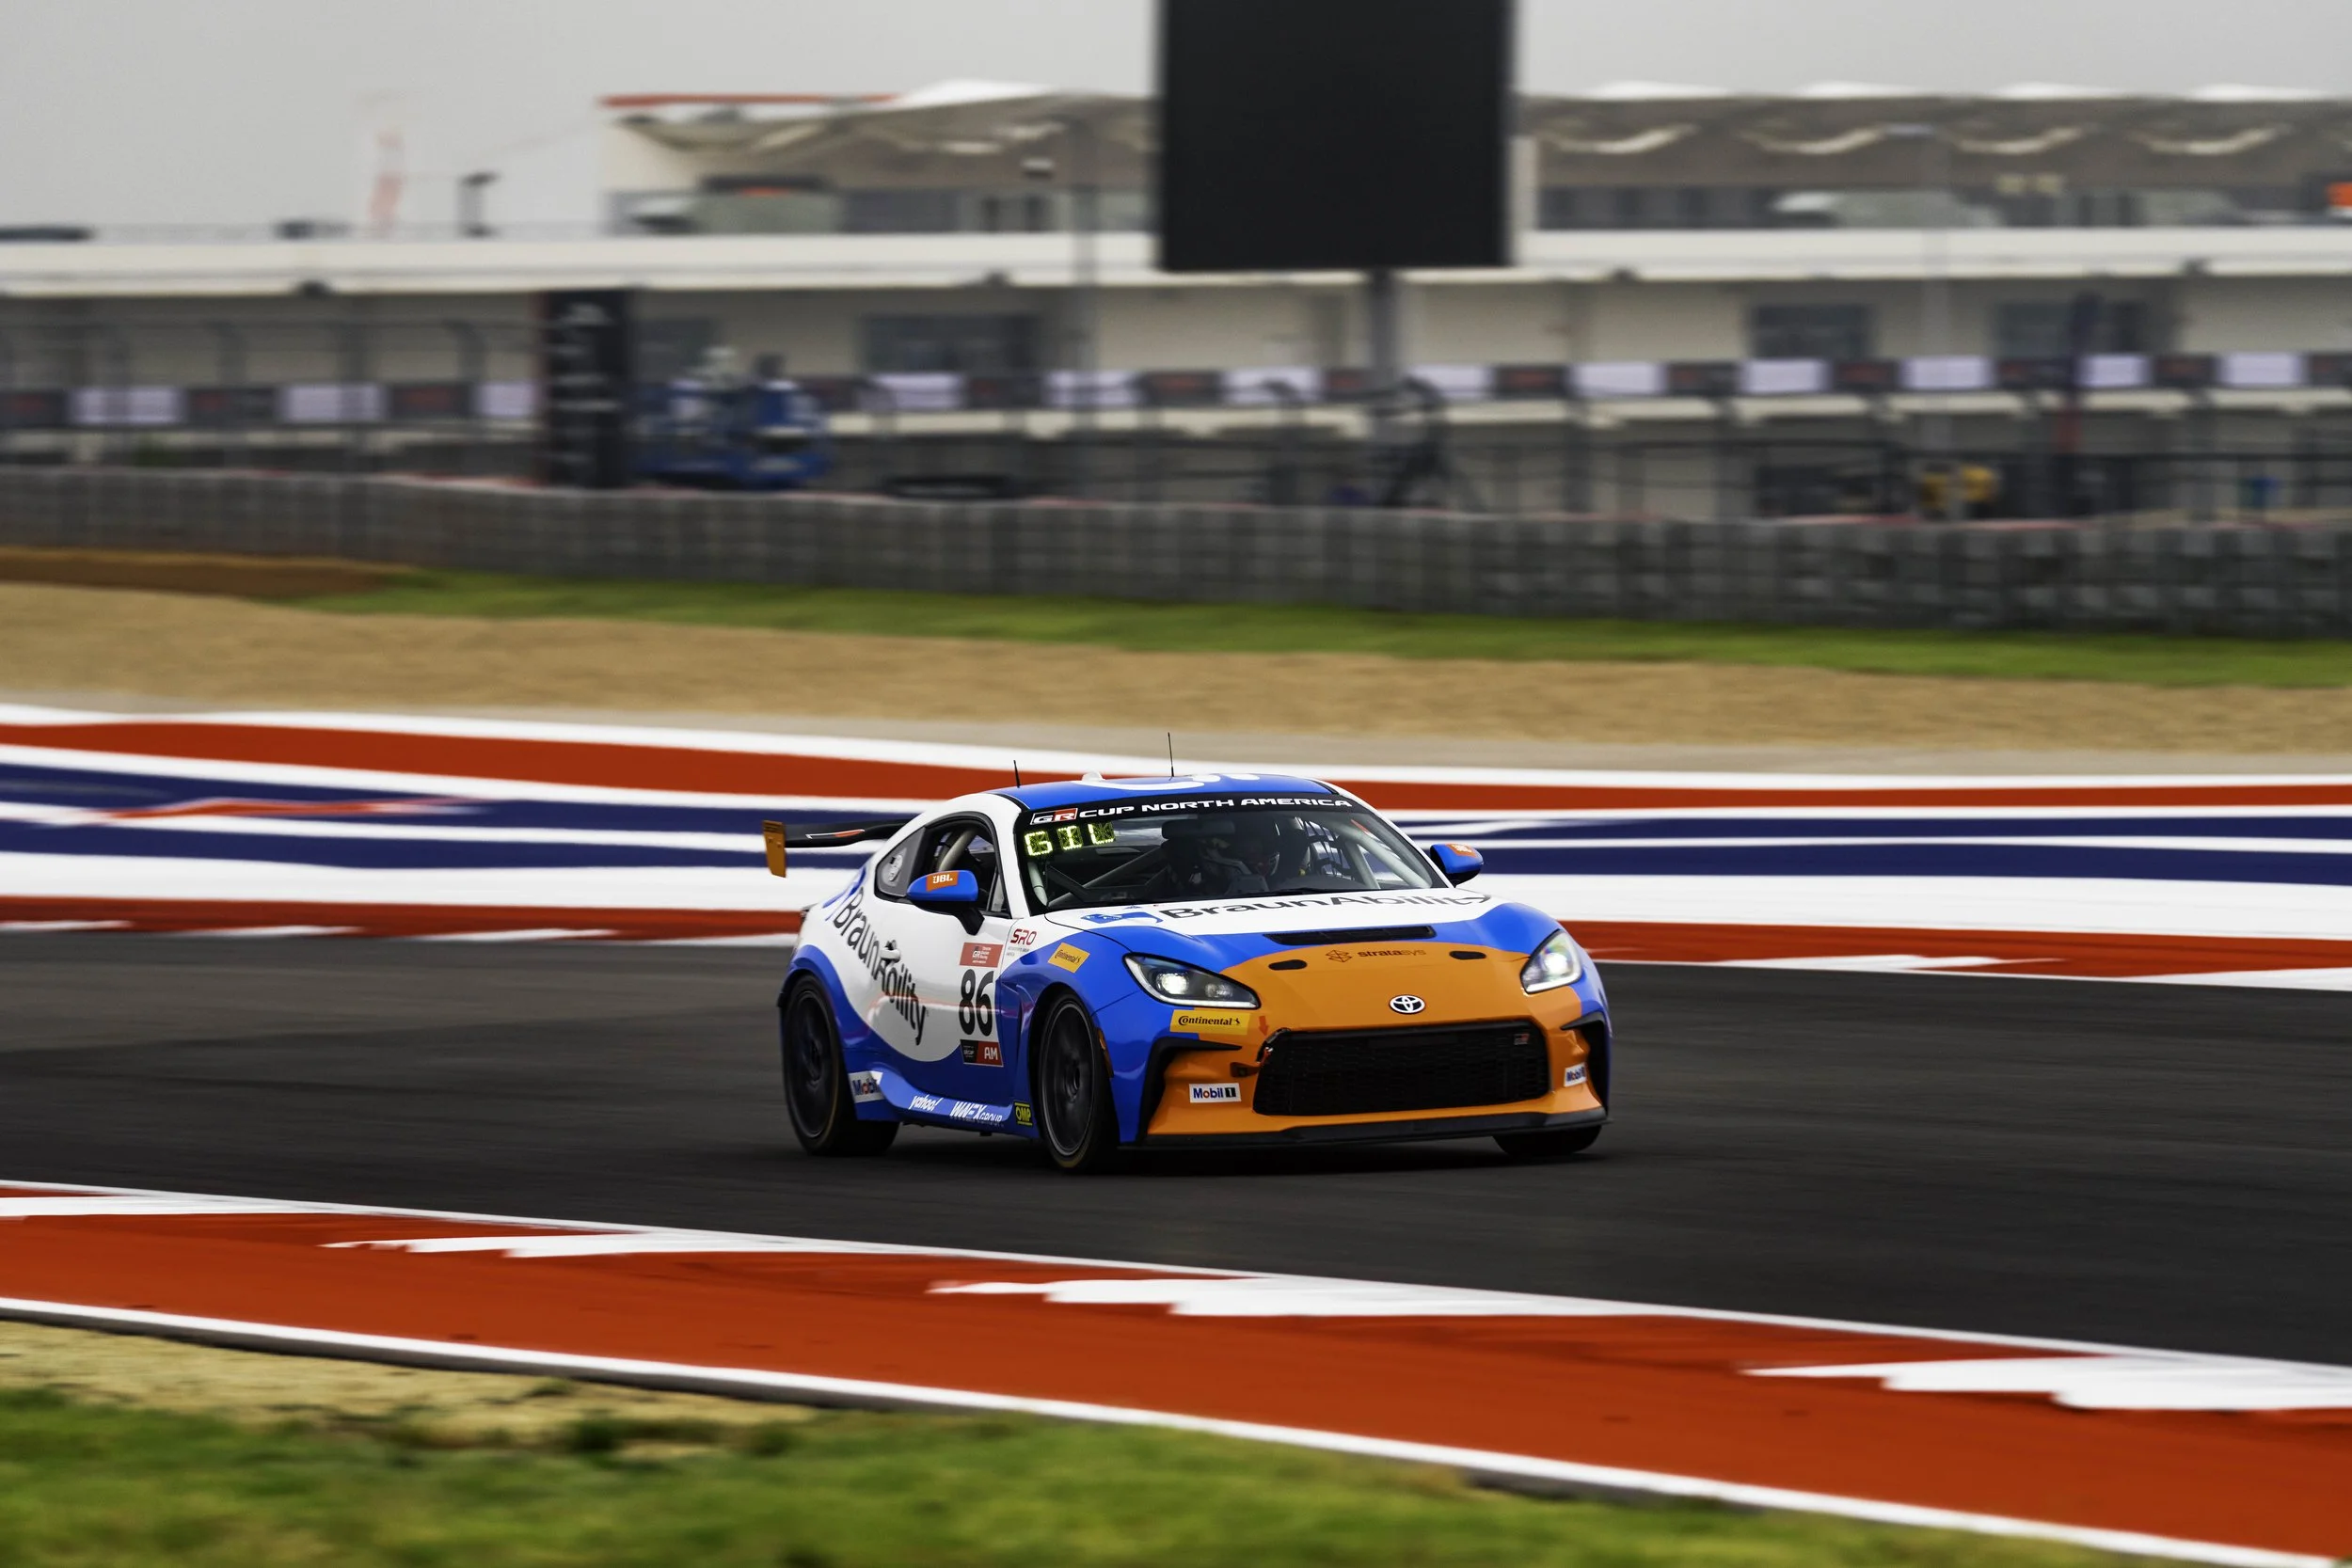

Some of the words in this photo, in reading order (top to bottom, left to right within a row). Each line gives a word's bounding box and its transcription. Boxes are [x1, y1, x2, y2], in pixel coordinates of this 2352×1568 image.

[1032, 812, 1075, 824] GR
[1079, 806, 1135, 818] CUP
[1141, 800, 1234, 813] NORTH
[1240, 798, 1353, 807] AMERICA
[1024, 822, 1115, 857] GIL
[932, 873, 953, 884] JBL
[1009, 928, 1038, 946] SRO
[1358, 947, 1427, 958] stratasys
[958, 968, 994, 1037] 86
[1178, 1015, 1233, 1026] Continental
[984, 1046, 999, 1061] AM
[1193, 1087, 1224, 1099] Mobil
[908, 1093, 944, 1112] yahoo!
[1015, 1106, 1032, 1122] OMP
